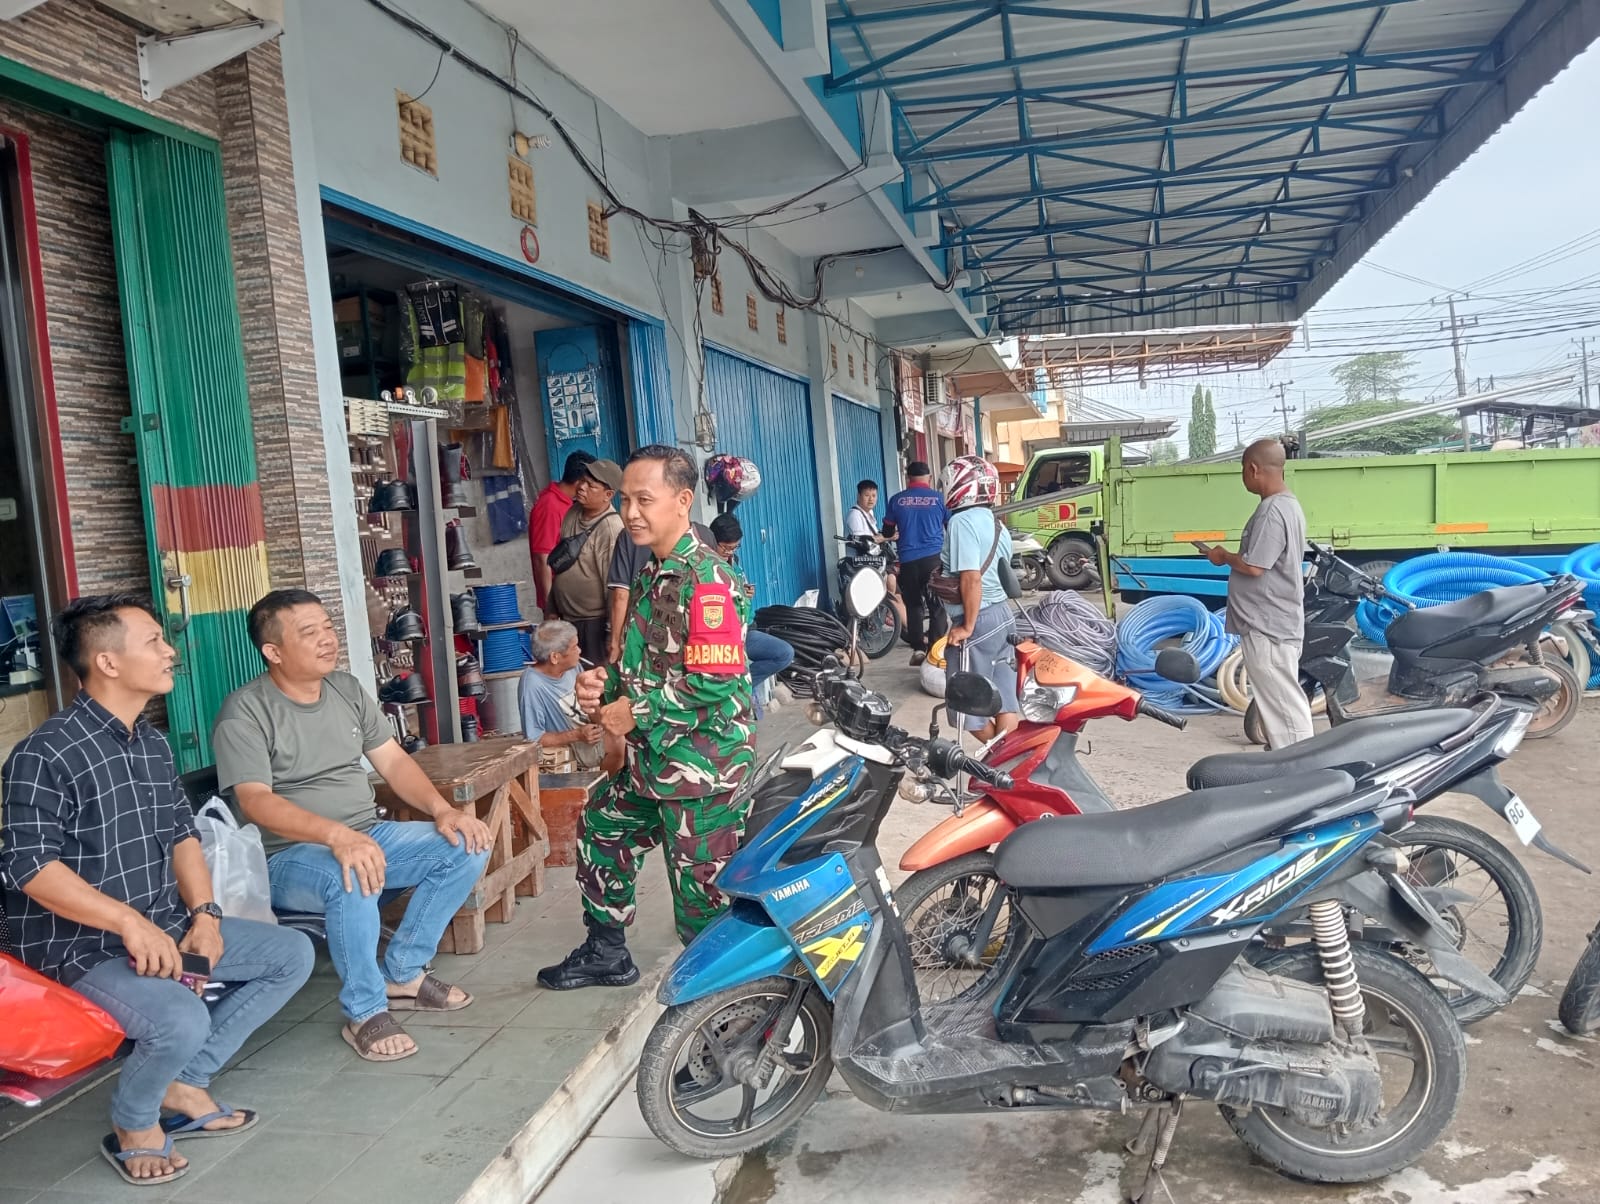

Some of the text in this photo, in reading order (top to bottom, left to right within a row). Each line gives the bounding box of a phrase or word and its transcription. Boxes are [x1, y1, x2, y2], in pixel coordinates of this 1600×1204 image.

[685, 645, 740, 665] BABINSA
[1508, 802, 1525, 825] BG
[771, 878, 811, 902] YAMAHA
[1300, 1094, 1337, 1110] YAMAHA
